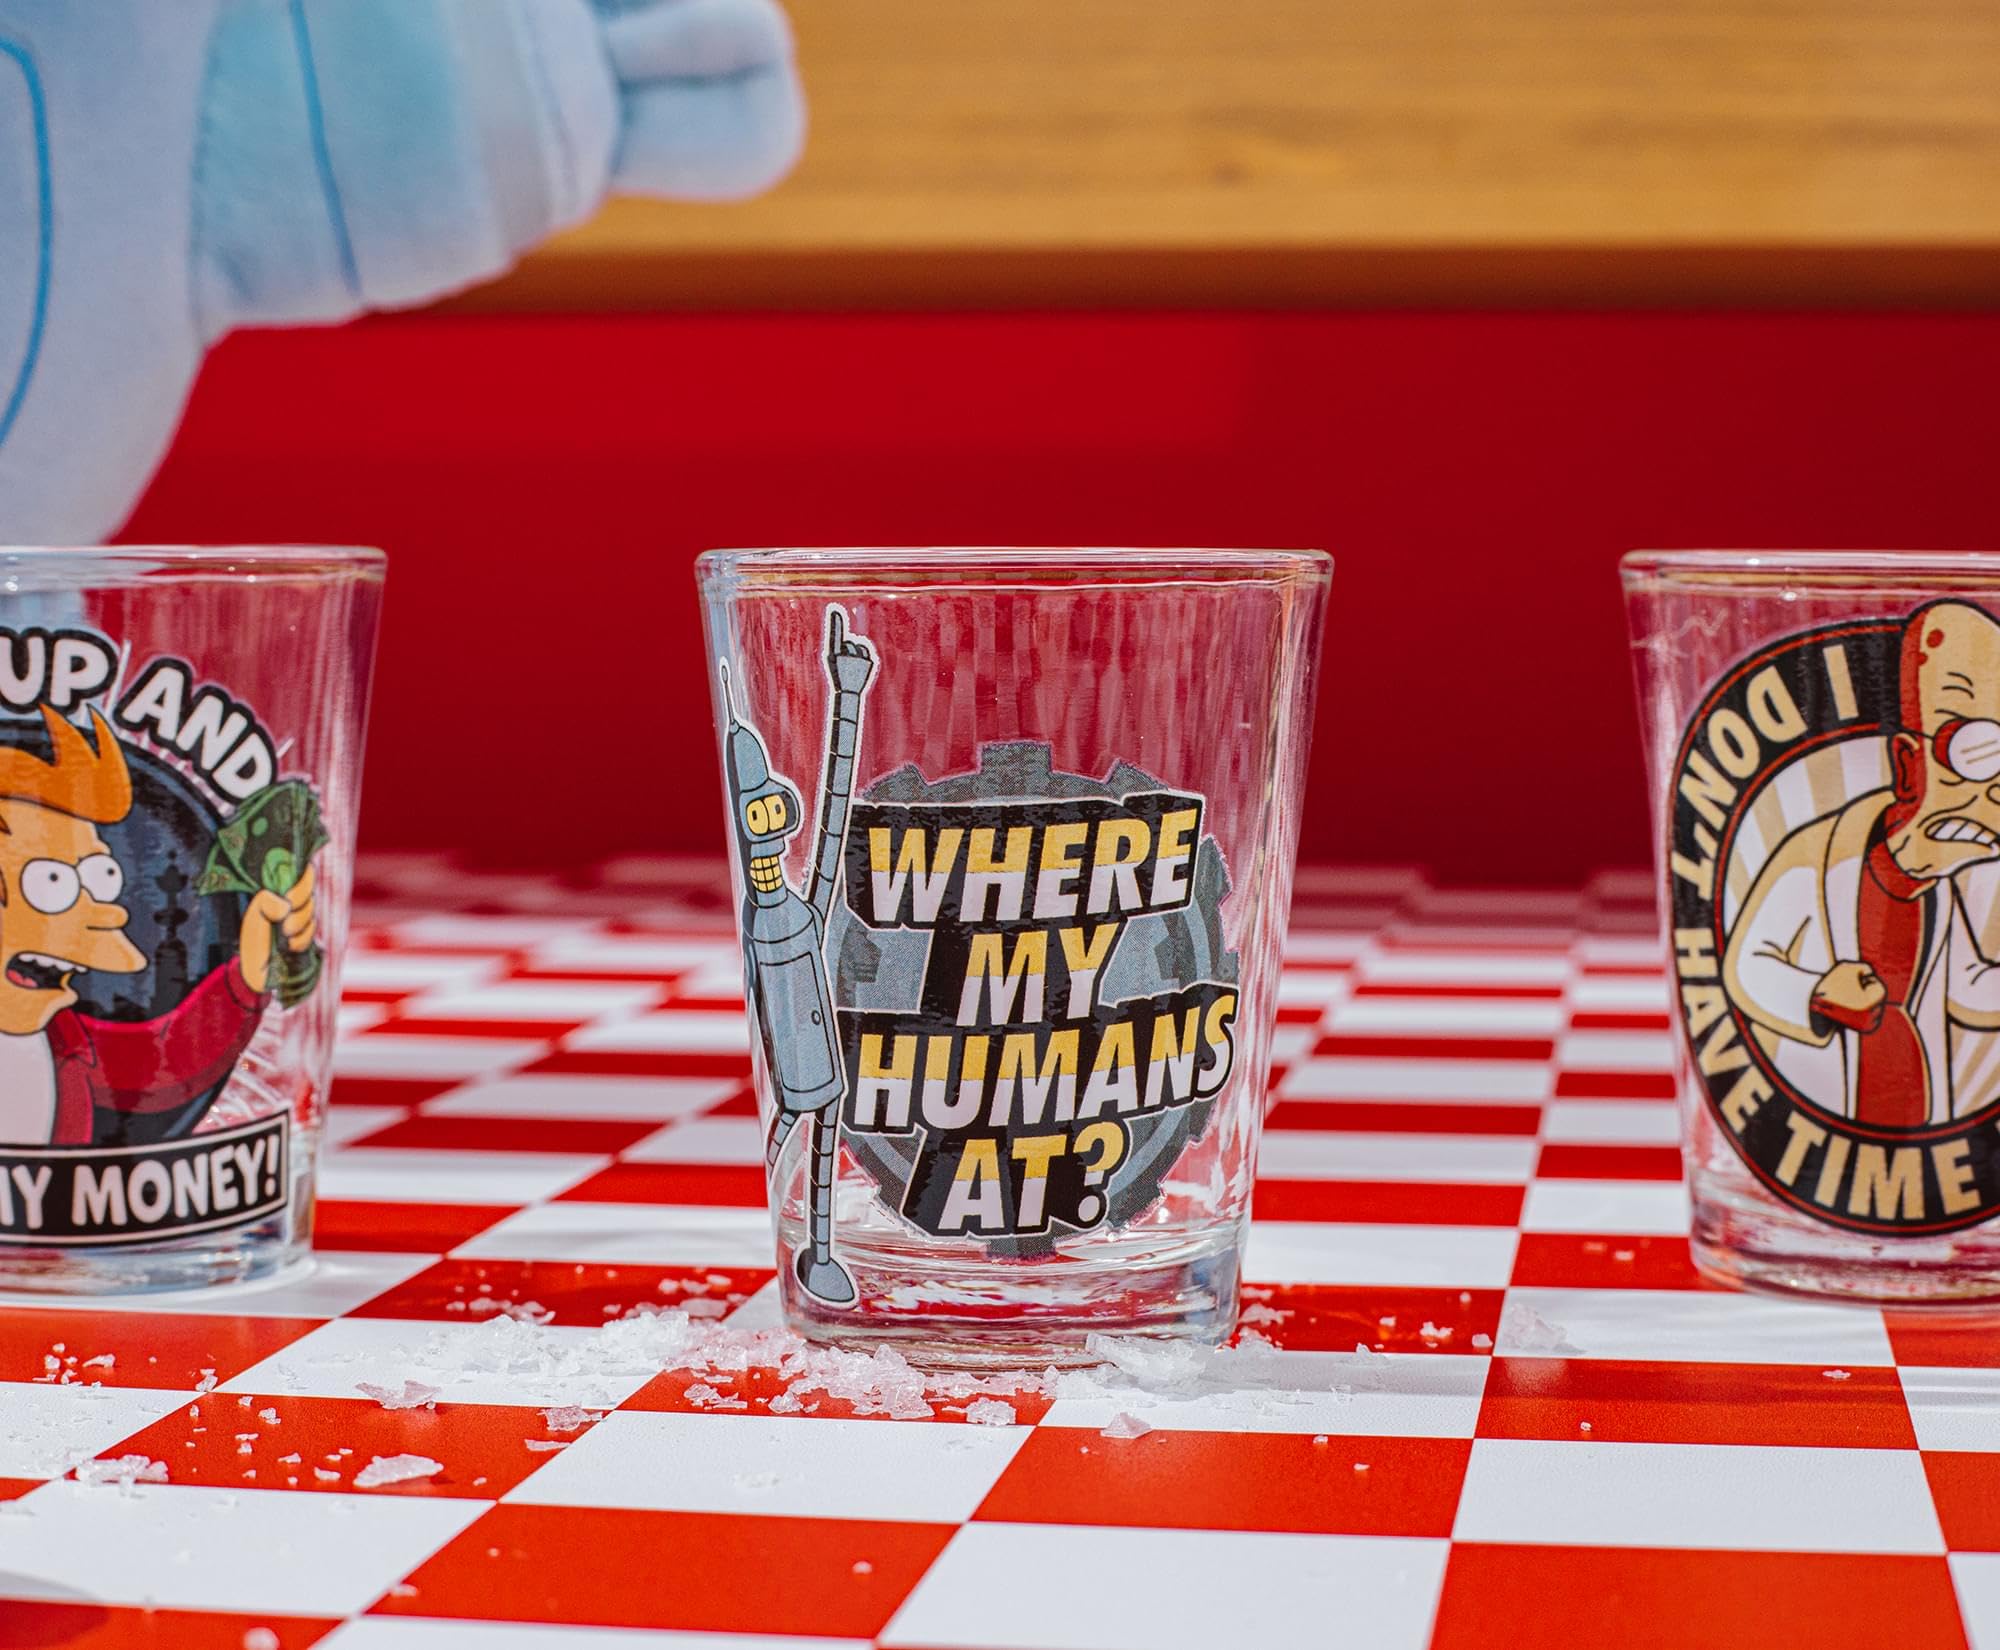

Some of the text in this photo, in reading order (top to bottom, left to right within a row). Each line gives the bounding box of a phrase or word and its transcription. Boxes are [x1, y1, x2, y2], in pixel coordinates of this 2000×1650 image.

[0, 636, 273, 799] UP AND
[867, 808, 1199, 923] WHERE
[955, 922, 1121, 1027] MY
[1671, 643, 1981, 1220] I DON'T HAVE TIME
[851, 994, 1237, 1131] HUMANS
[0, 1133, 280, 1230] Y MONEY!
[937, 1120, 1126, 1231] AT?
